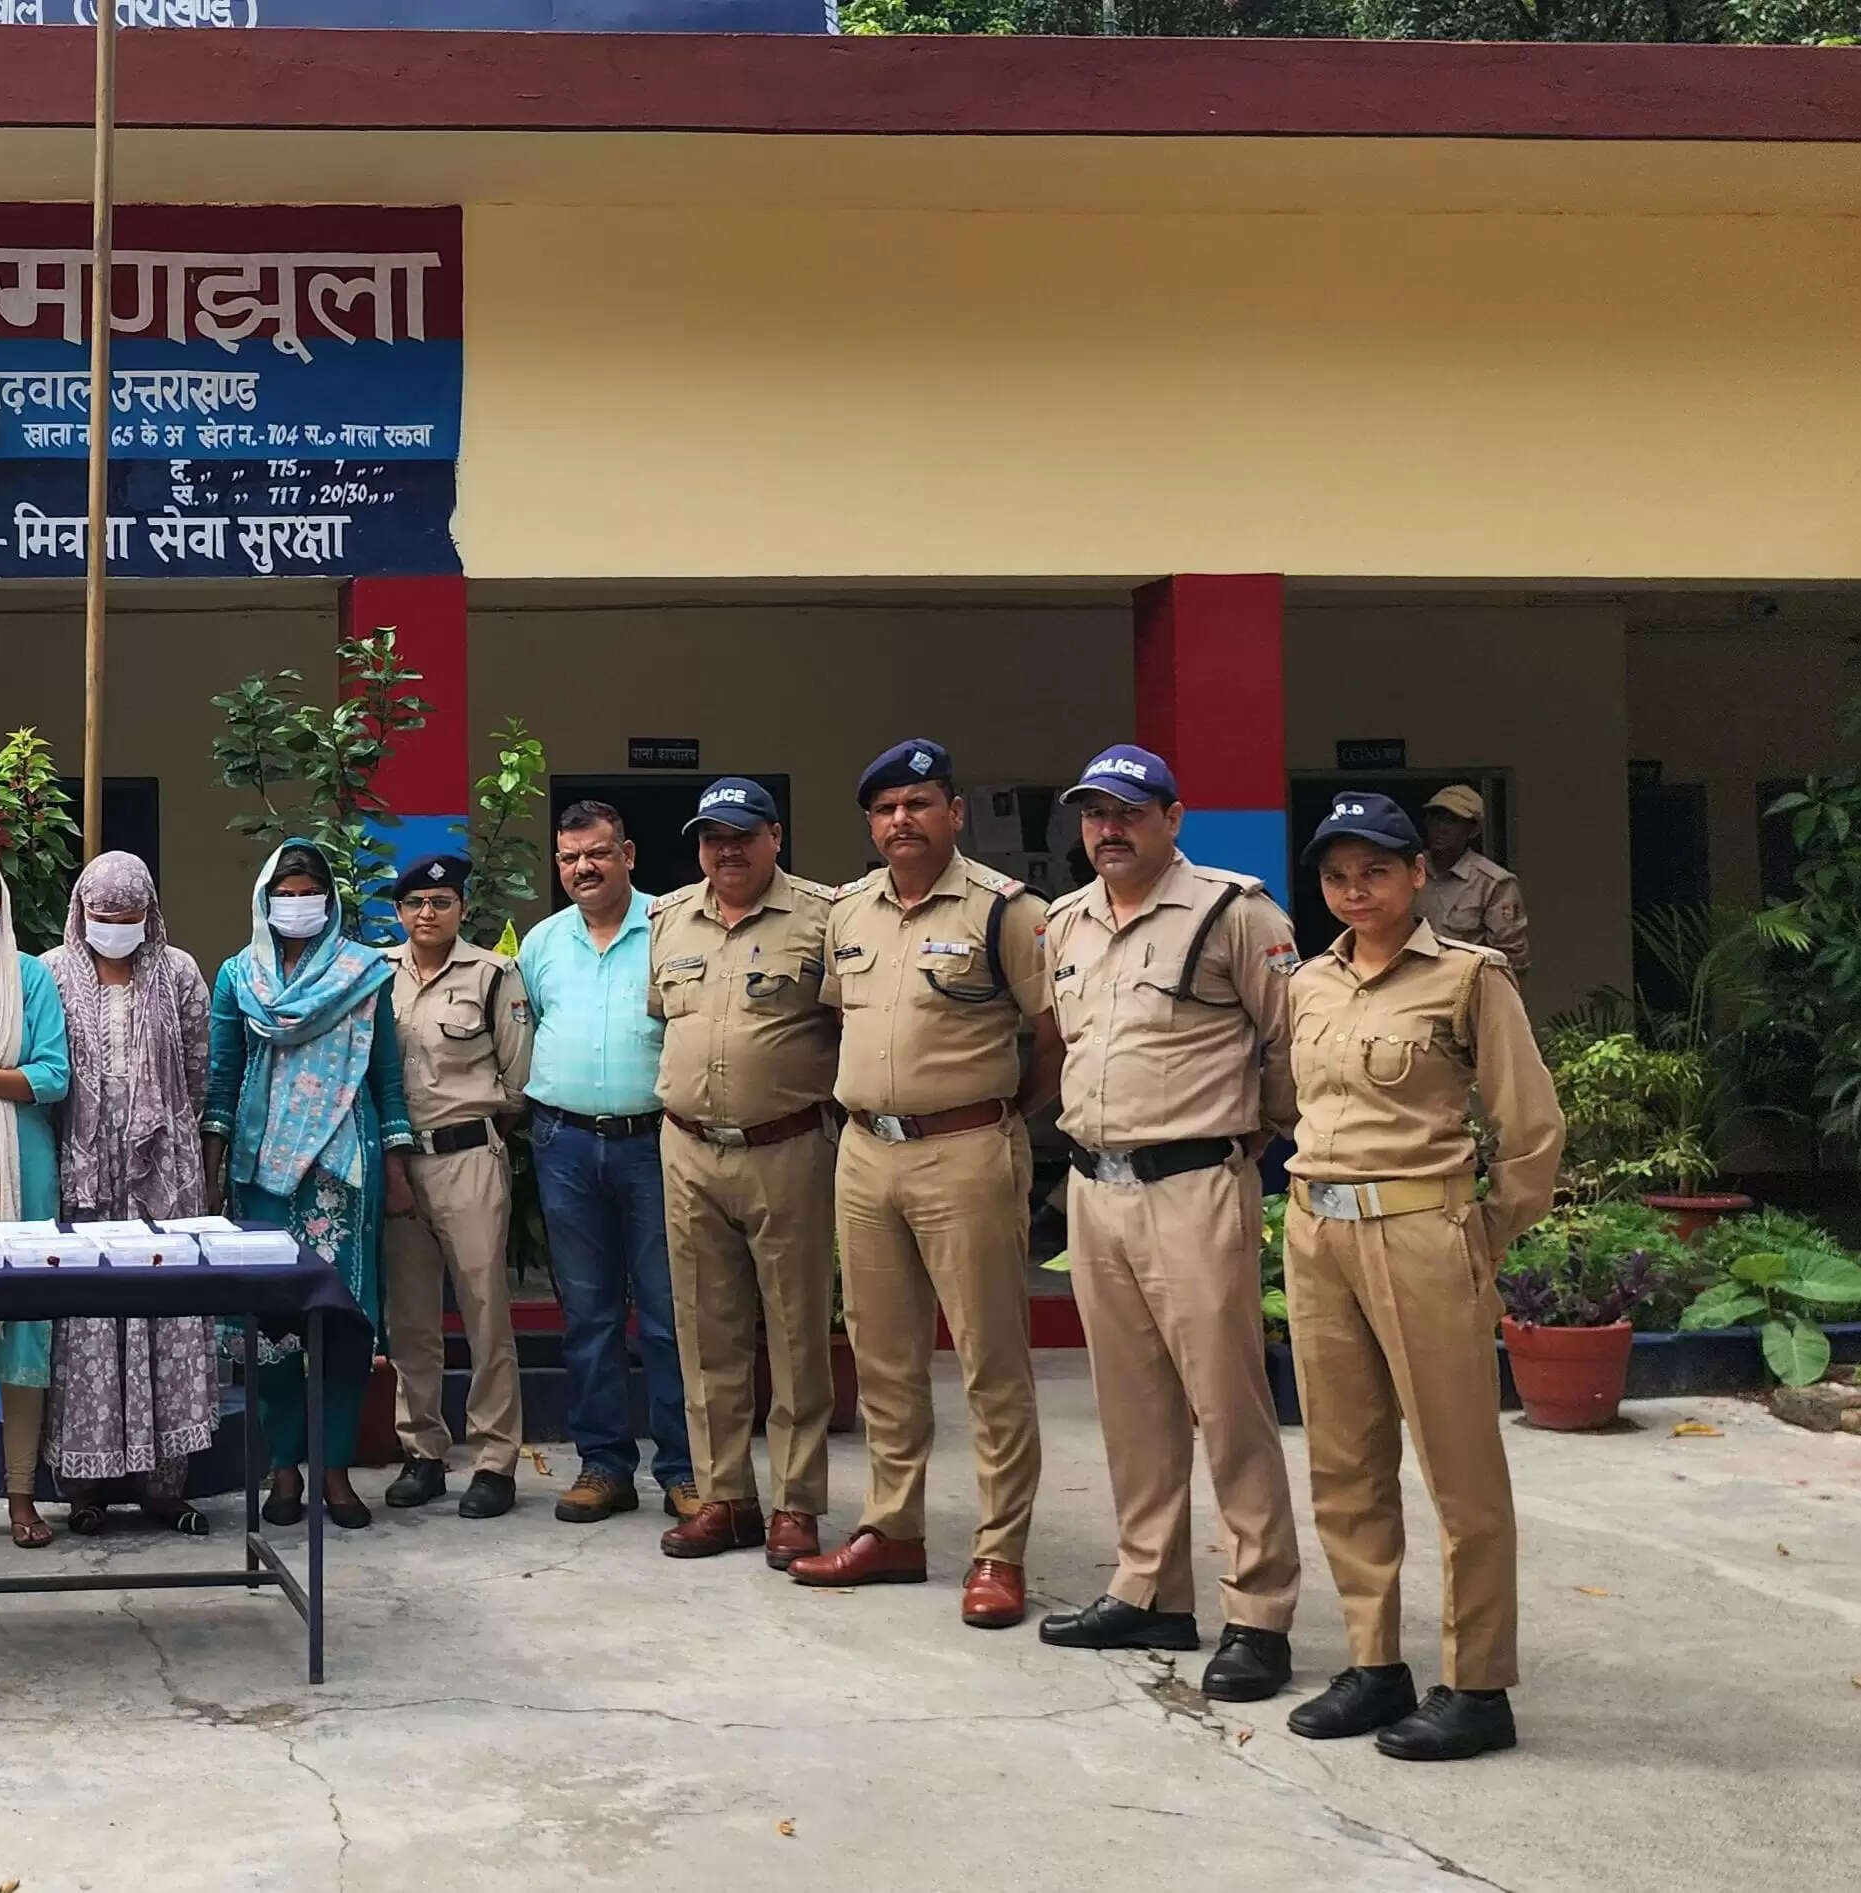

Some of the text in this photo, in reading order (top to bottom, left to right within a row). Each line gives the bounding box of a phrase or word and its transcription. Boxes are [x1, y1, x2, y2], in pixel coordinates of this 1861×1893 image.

[111, 370, 260, 413] उत्तराखण्ड
[22, 423, 74, 448] खाता
[140, 418, 159, 447] के
[164, 425, 186, 448] अ
[196, 418, 236, 449] खेत
[341, 424, 381, 448] नाला
[383, 425, 434, 448] रकवा
[147, 505, 227, 562] सेवा
[237, 513, 352, 573] सुरक्षा
